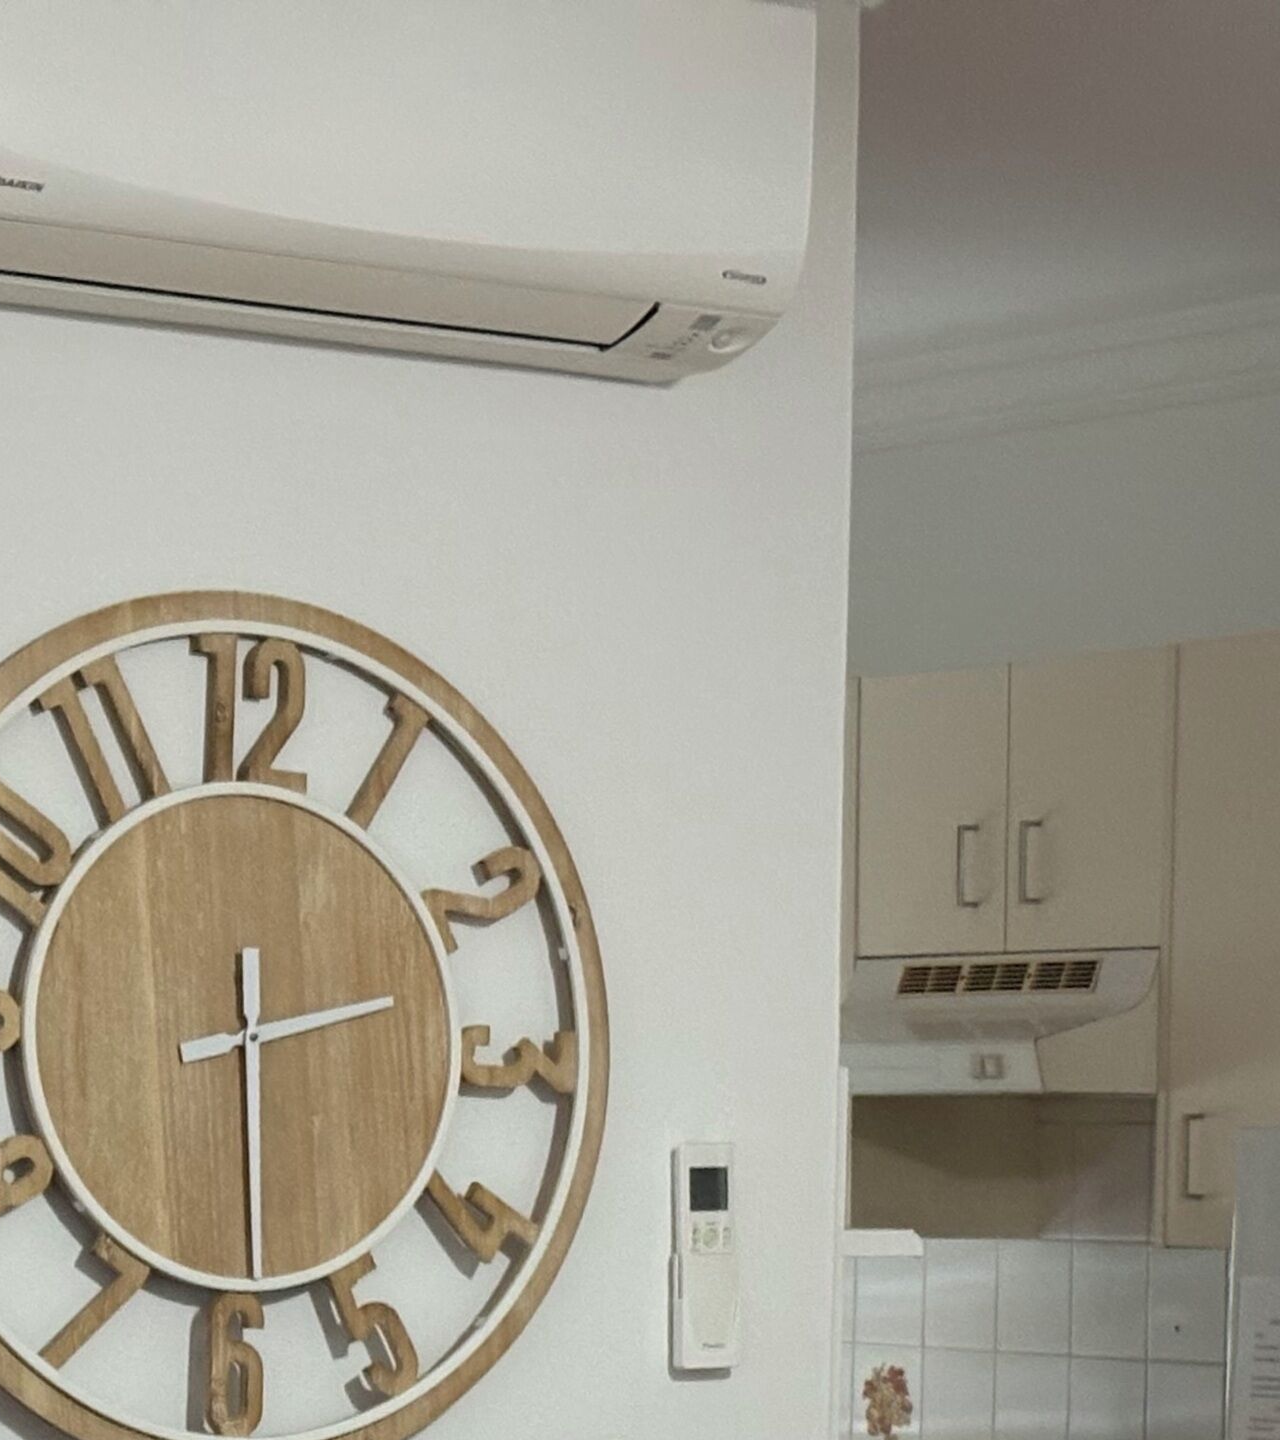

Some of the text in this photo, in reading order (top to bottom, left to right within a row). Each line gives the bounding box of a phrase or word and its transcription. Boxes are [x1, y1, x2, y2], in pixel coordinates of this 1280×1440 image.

[31, 655, 172, 830] 11
[190, 632, 307, 794] 12
[345, 692, 431, 829] 1
[422, 846, 541, 953] 2
[462, 1025, 575, 1094] 3
[425, 1169, 539, 1262] 4
[39, 1231, 150, 1368] 7
[209, 1292, 263, 1436] 6
[326, 1253, 419, 1396] 5
